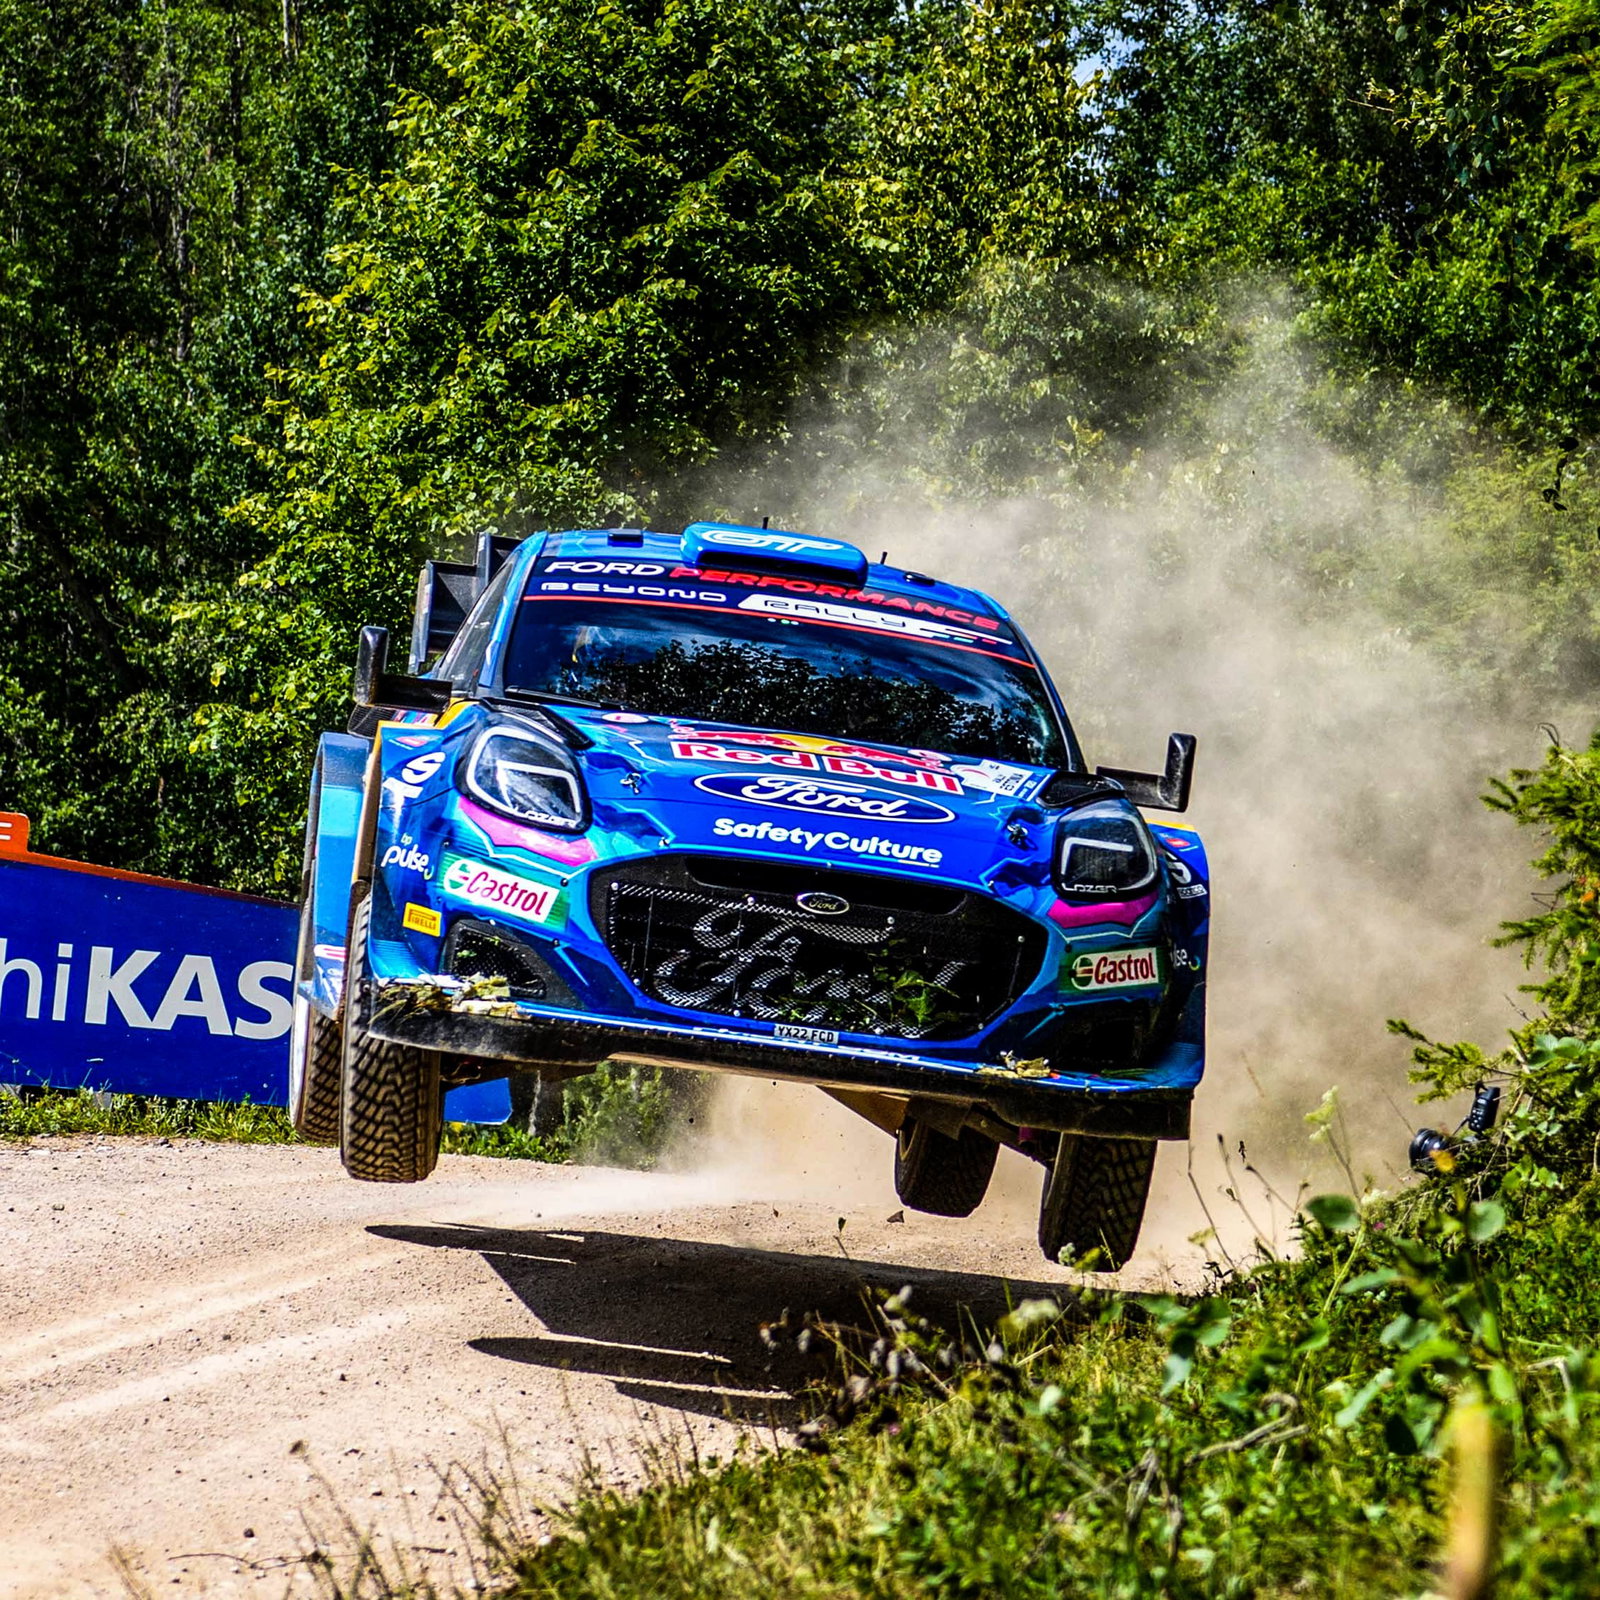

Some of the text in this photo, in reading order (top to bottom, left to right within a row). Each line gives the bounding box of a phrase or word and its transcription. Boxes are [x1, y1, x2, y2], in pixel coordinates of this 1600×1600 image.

[541, 582, 906, 628] BEYOND RALLY
[544, 561, 999, 630] FORD PERFORMANCE
[671, 740, 821, 772] Red
[824, 755, 965, 795] Bull
[741, 775, 909, 818] Ford
[381, 843, 430, 873] pulse
[401, 832, 413, 845] bp
[713, 817, 944, 864] SafetyCulture
[466, 870, 549, 916] Castrol
[407, 907, 437, 931] PIRELLI
[1094, 952, 1156, 985] Castrol
[777, 1026, 834, 1043] YX22 FCD
